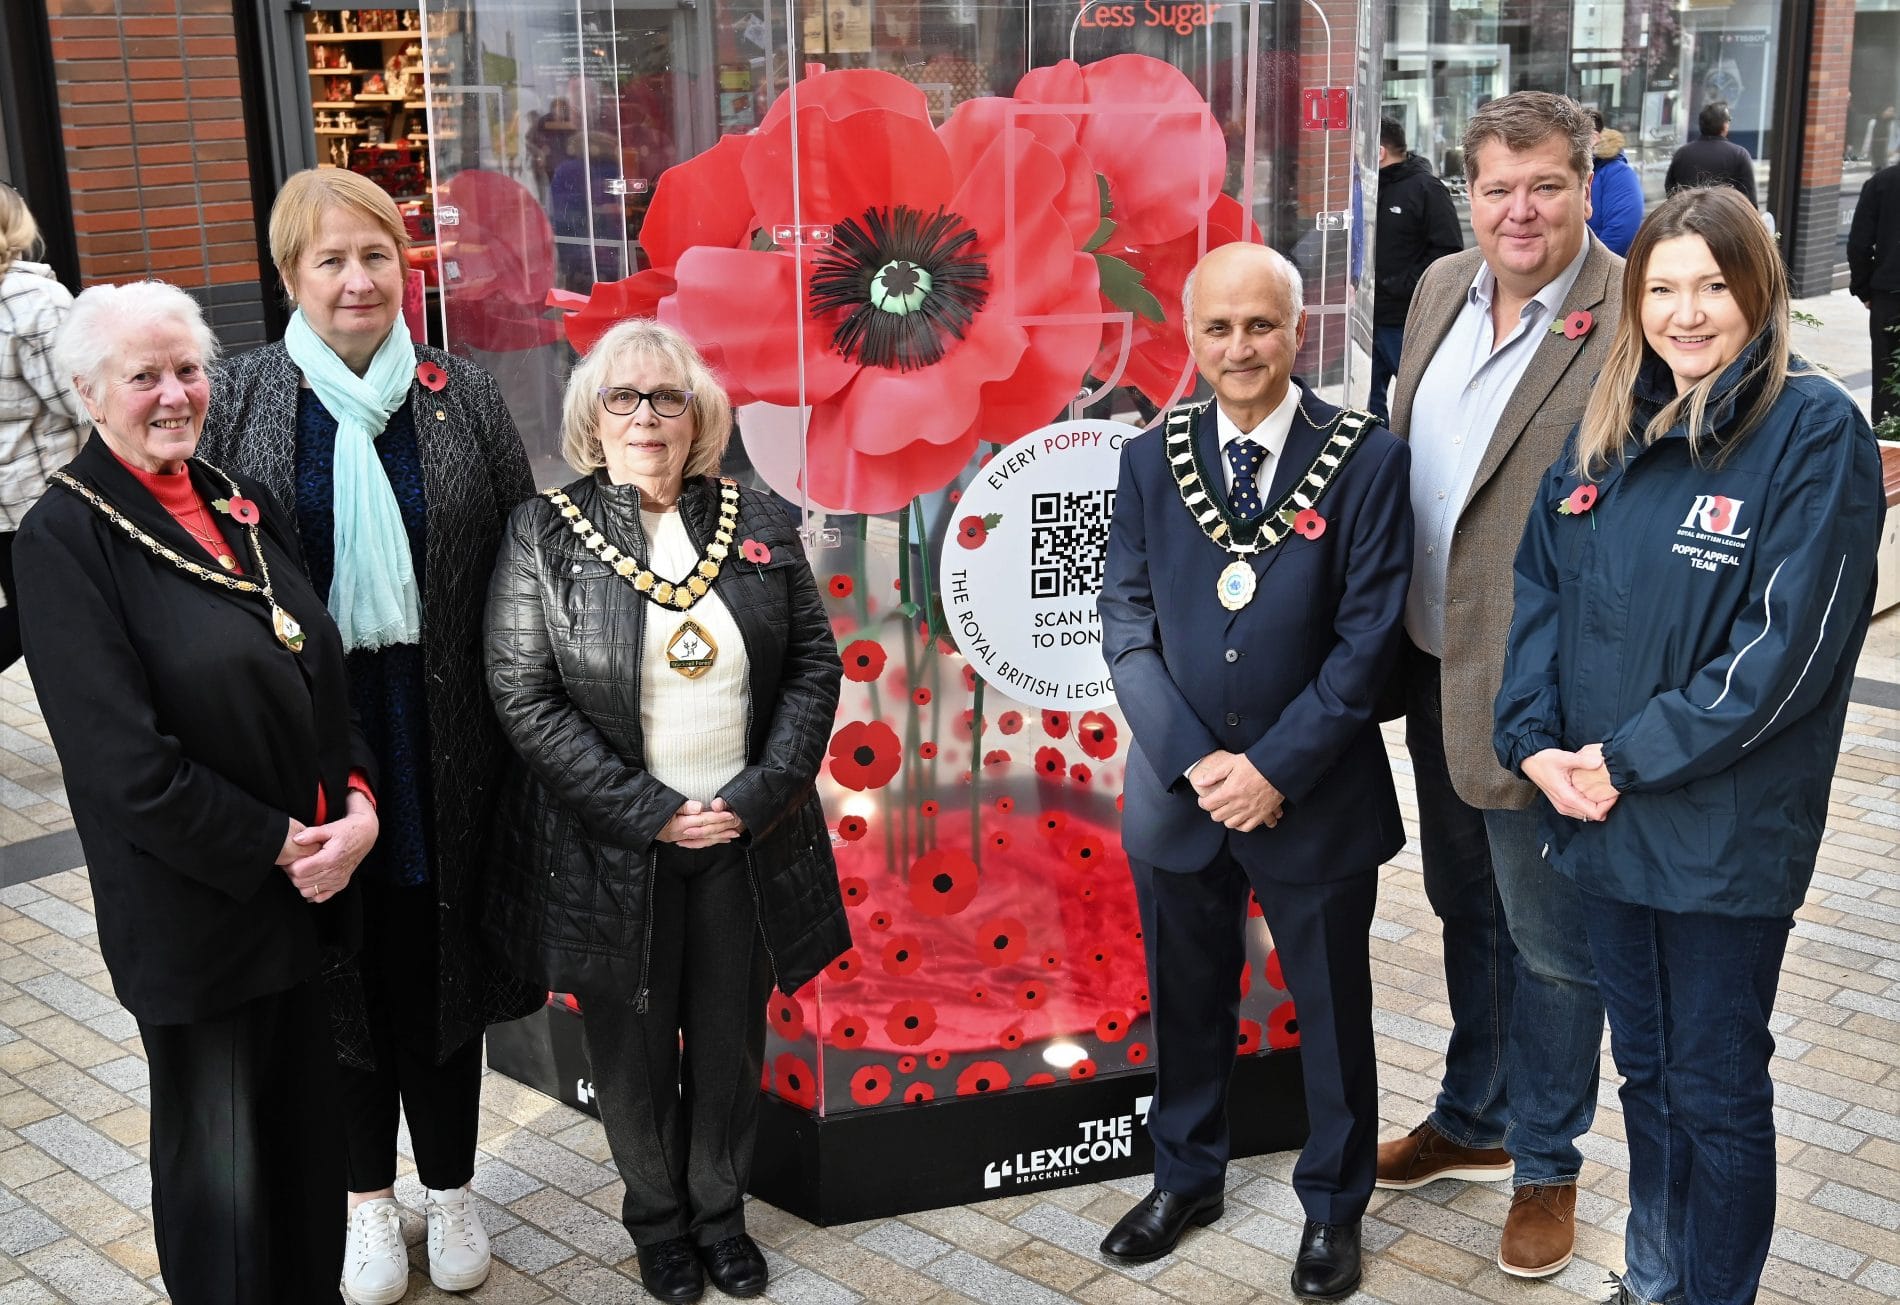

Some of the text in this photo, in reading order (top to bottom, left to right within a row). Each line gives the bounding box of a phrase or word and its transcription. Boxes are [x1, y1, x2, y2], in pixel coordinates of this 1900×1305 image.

[1080, 0, 1222, 36] Less Sugar
[987, 445, 1036, 490] EVERY
[1044, 431, 1102, 454] POPPY
[1671, 543, 1740, 566] POPPY APPEAL
[1721, 538, 1746, 549] LEGION
[1690, 557, 1717, 572] TEAM
[951, 569, 969, 605] THE
[1034, 610, 1082, 628] SCAN
[958, 610, 997, 666] ROYAL
[1031, 629, 1101, 649] TO DON
[996, 661, 1059, 698] BRITISH
[1078, 1115, 1133, 1142] THE
[1016, 1136, 1133, 1175] LEXICON
[1016, 1167, 1081, 1184] BRACKNELL
